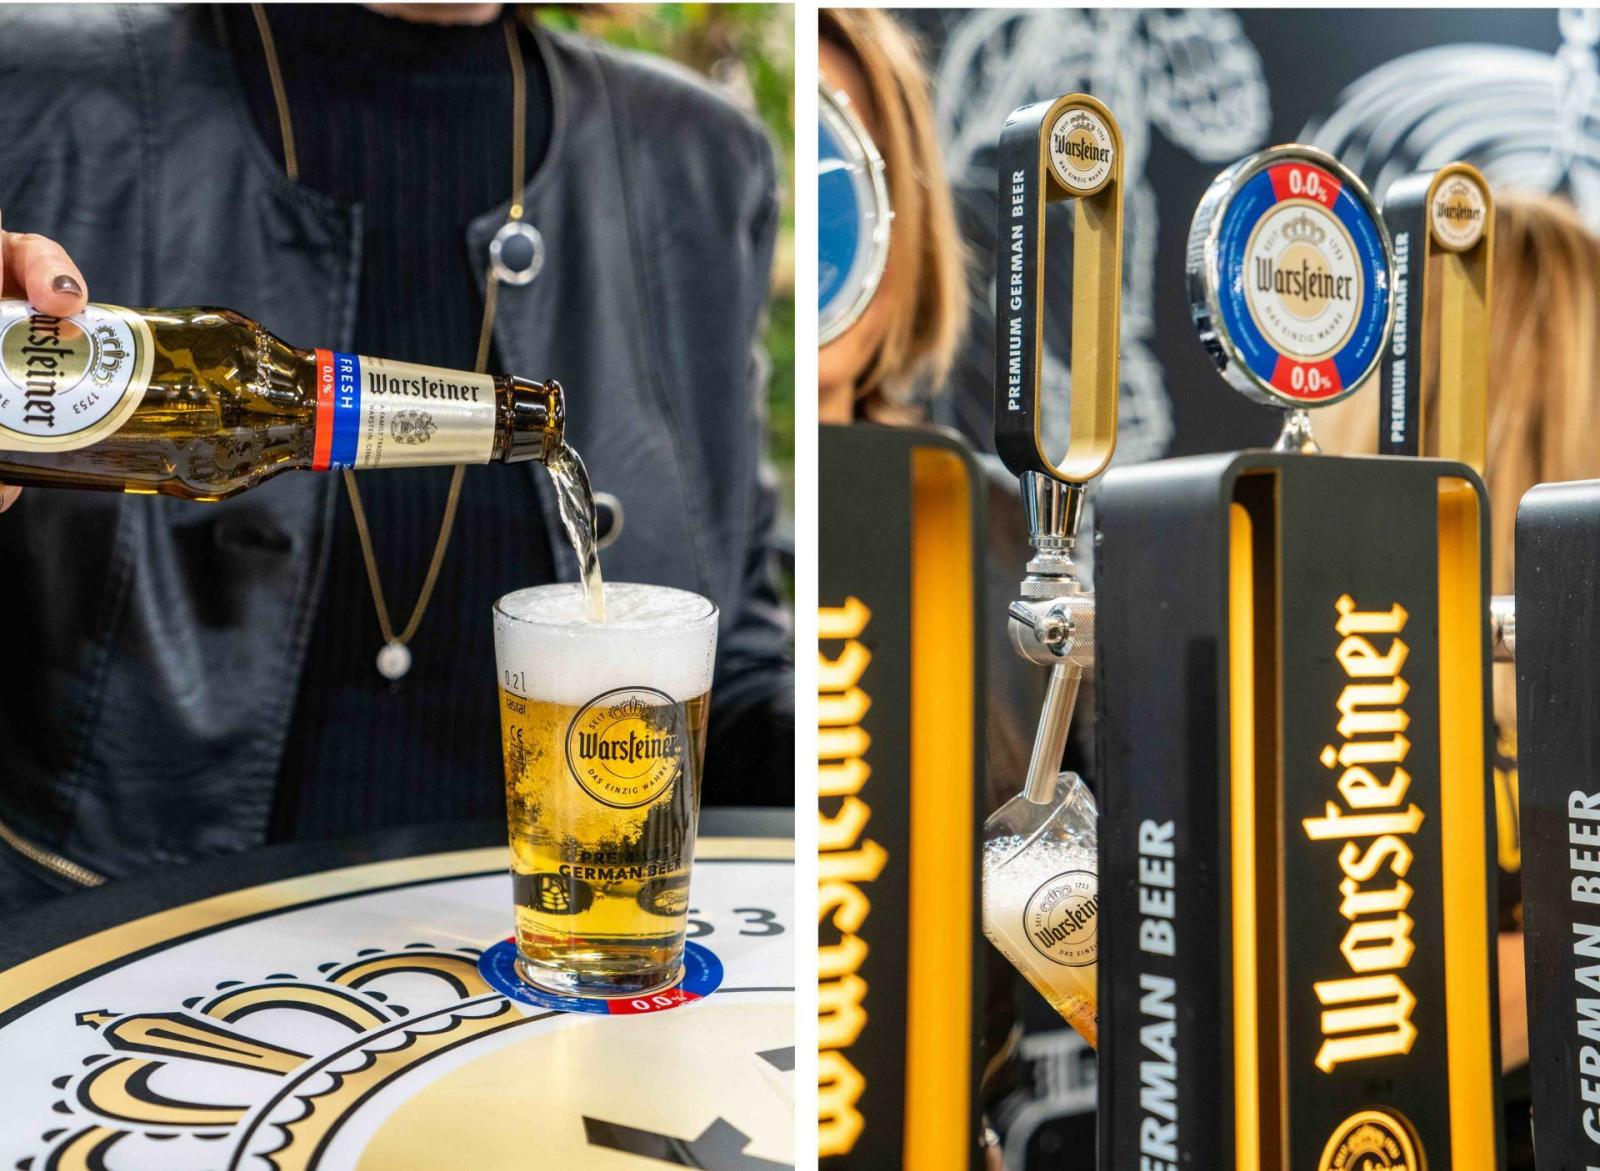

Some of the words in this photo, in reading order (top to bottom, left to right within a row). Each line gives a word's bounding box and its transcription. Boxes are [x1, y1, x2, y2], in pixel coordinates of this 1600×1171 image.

[1054, 132, 1110, 163] Warsteiner
[1012, 169, 1025, 217] BEER
[1010, 224, 1023, 311] GERMAN
[1394, 231, 1409, 275] BEER
[1255, 255, 1353, 302] Warsteiner
[1393, 279, 1408, 357] GERMAN
[21, 308, 75, 429] arsteiner
[340, 358, 353, 409] FRESH
[368, 371, 480, 403] Warsteiner
[1008, 317, 1022, 411] PREMIUM
[73, 392, 100, 414] 1753
[1391, 358, 1406, 443] PREMIUM
[588, 712, 606, 730] SEIT
[578, 730, 678, 764] Warsteiner
[587, 768, 604, 785] DAS
[605, 783, 639, 795] EINZIG
[1303, 593, 1425, 1076] Warsteiner
[1568, 789, 1600, 904] BEER
[558, 864, 643, 881] GERMAN
[647, 858, 682, 878] BEER
[1138, 818, 1176, 957] BEER
[1034, 894, 1099, 949] Warstein
